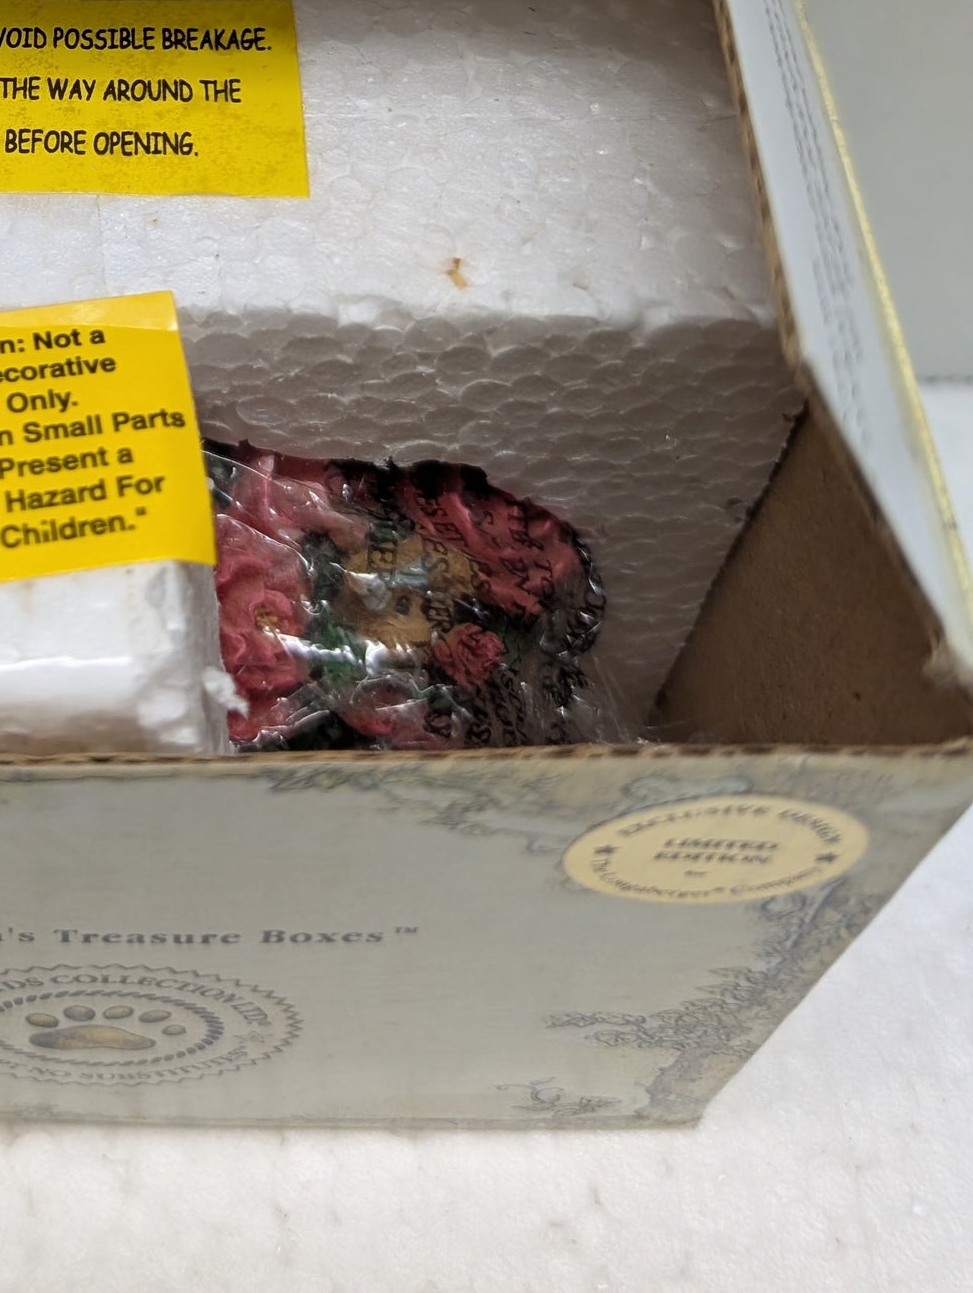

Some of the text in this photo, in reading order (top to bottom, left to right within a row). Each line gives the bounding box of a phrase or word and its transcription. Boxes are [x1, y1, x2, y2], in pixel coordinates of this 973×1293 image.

[53, 27, 156, 50] POSSIBLE
[162, 27, 272, 51] BREAKAGE.
[0, 76, 41, 101] THE
[47, 78, 96, 102] WAY
[103, 78, 193, 103] AROUND
[199, 78, 242, 103] THE
[5, 128, 87, 155] BEFORE
[93, 131, 199, 157] OPENING.
[33, 328, 82, 351] Not
[90, 328, 106, 345] a
[7, 388, 79, 415] Only.
[23, 414, 103, 444] Small
[112, 407, 186, 433] Parts
[117, 448, 134, 465] a
[4, 481, 107, 514] Hazard
[116, 473, 165, 499] For
[0, 506, 147, 550] Children."
[618, 804, 842, 845] EXCLUSIVE DESIGN
[653, 850, 772, 864] EDITION
[664, 837, 779, 851] LIMITED
[54, 928, 242, 945] Treasure
[50, 973, 243, 1004] COLLECTION
[29, 1066, 71, 1077] NO
[79, 1045, 248, 1080] SUBSTITUTES
